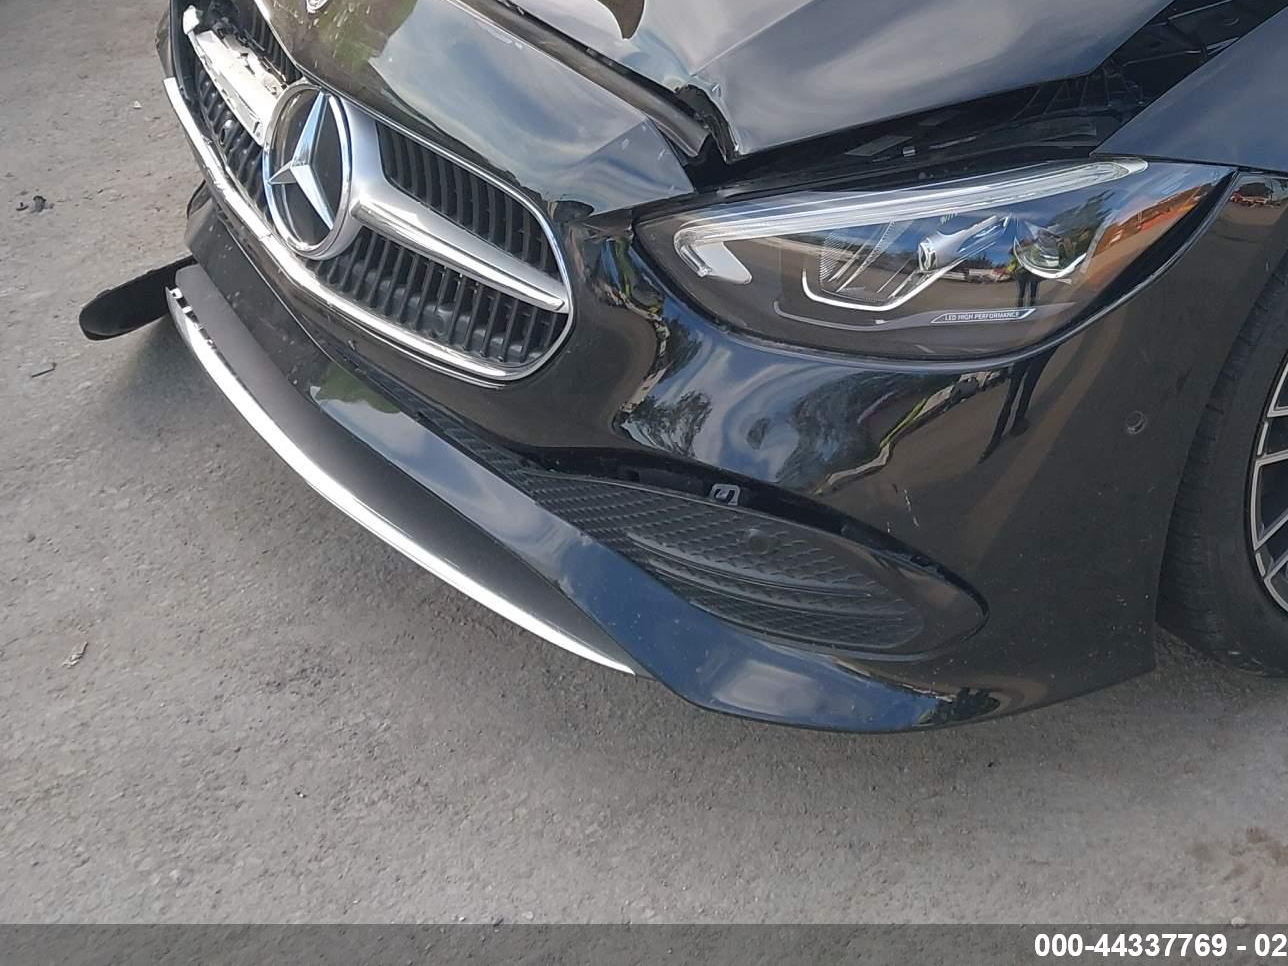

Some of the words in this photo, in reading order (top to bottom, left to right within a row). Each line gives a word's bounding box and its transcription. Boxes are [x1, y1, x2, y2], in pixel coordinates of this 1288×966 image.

[944, 313, 957, 321] LED
[957, 312, 974, 321] HIGH
[974, 311, 1020, 320] PERFORMANCE
